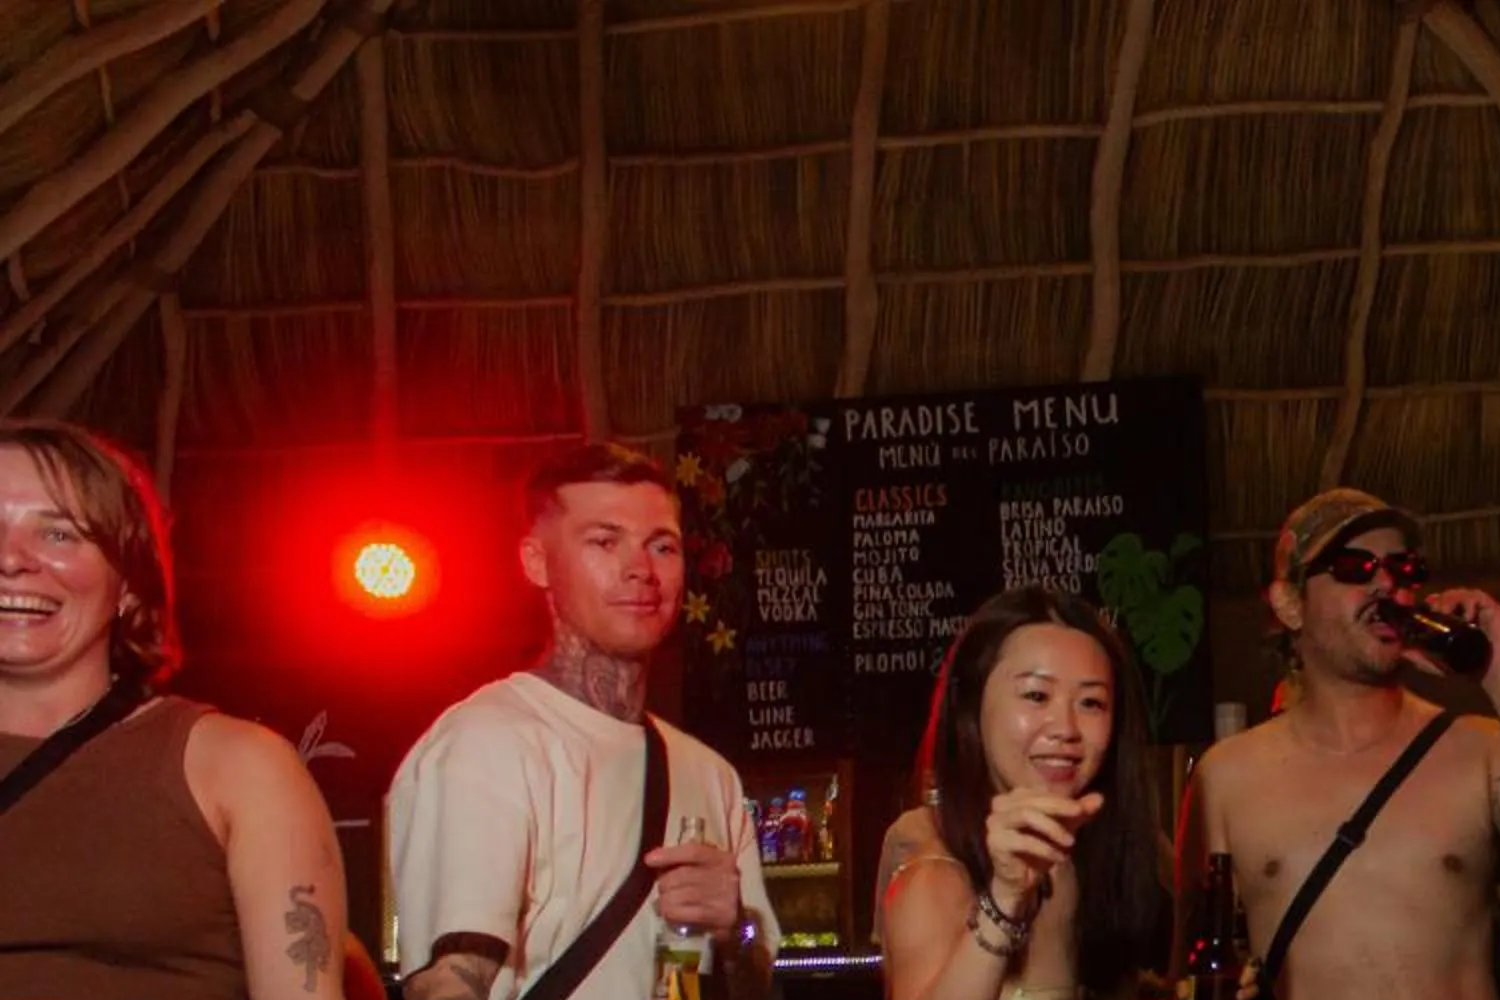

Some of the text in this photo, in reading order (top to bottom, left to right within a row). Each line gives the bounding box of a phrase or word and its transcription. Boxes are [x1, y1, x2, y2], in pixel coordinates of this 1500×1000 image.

[844, 393, 1119, 442] PARADISE MENU
[855, 483, 949, 513] CLASSICS
[853, 511, 936, 529] MARGARITA
[1001, 516, 1066, 539] LATINO
[853, 529, 921, 548] PALOMA
[1002, 533, 1081, 558] TROPICAL
[853, 547, 921, 566] MOJITO
[753, 567, 828, 587] TEQUILA
[853, 565, 905, 585] CUBA
[756, 585, 822, 605] MEZCAL
[896, 581, 957, 602] COLADA
[758, 604, 819, 623] VODKA
[853, 600, 936, 621] GIN TONIC
[853, 619, 925, 640] ESPRESSO
[746, 680, 789, 703] BEER
